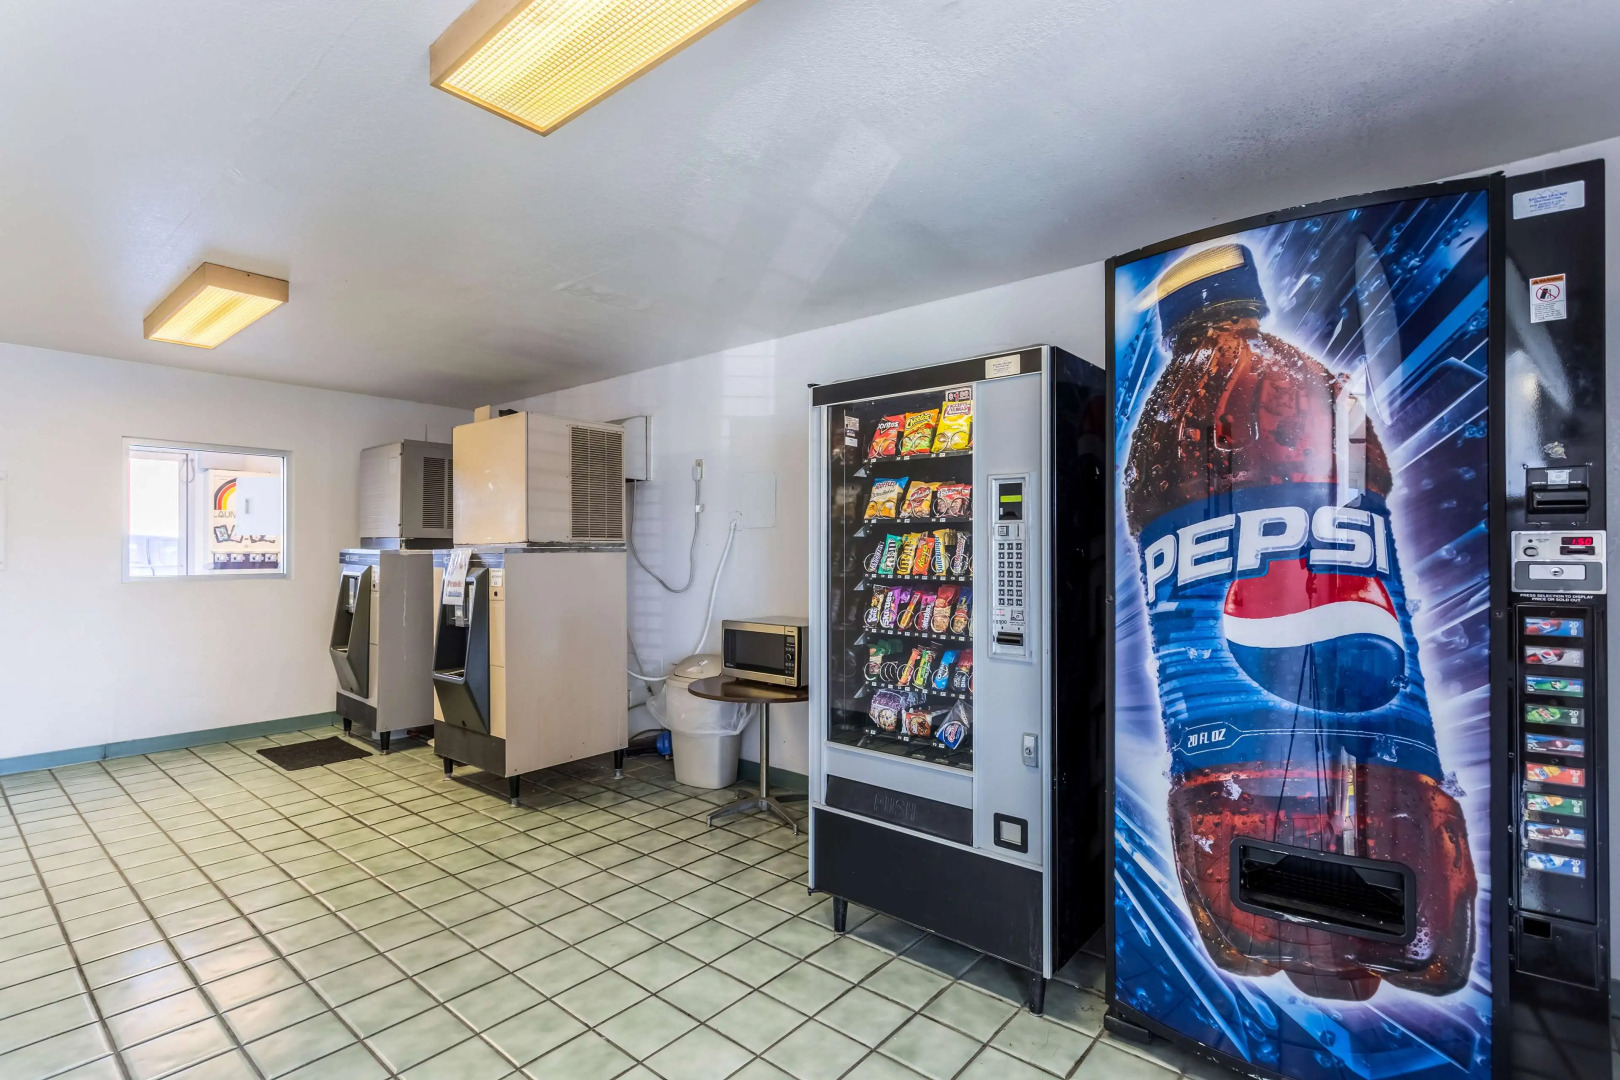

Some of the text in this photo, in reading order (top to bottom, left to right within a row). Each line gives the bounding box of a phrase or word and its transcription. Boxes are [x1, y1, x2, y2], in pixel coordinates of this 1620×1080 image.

[934, 535, 943, 573] Butterfinger
[1144, 506, 1390, 603] PEPSI
[1572, 538, 1592, 546] 1.50
[1188, 728, 1226, 748] 20 FL OZ
